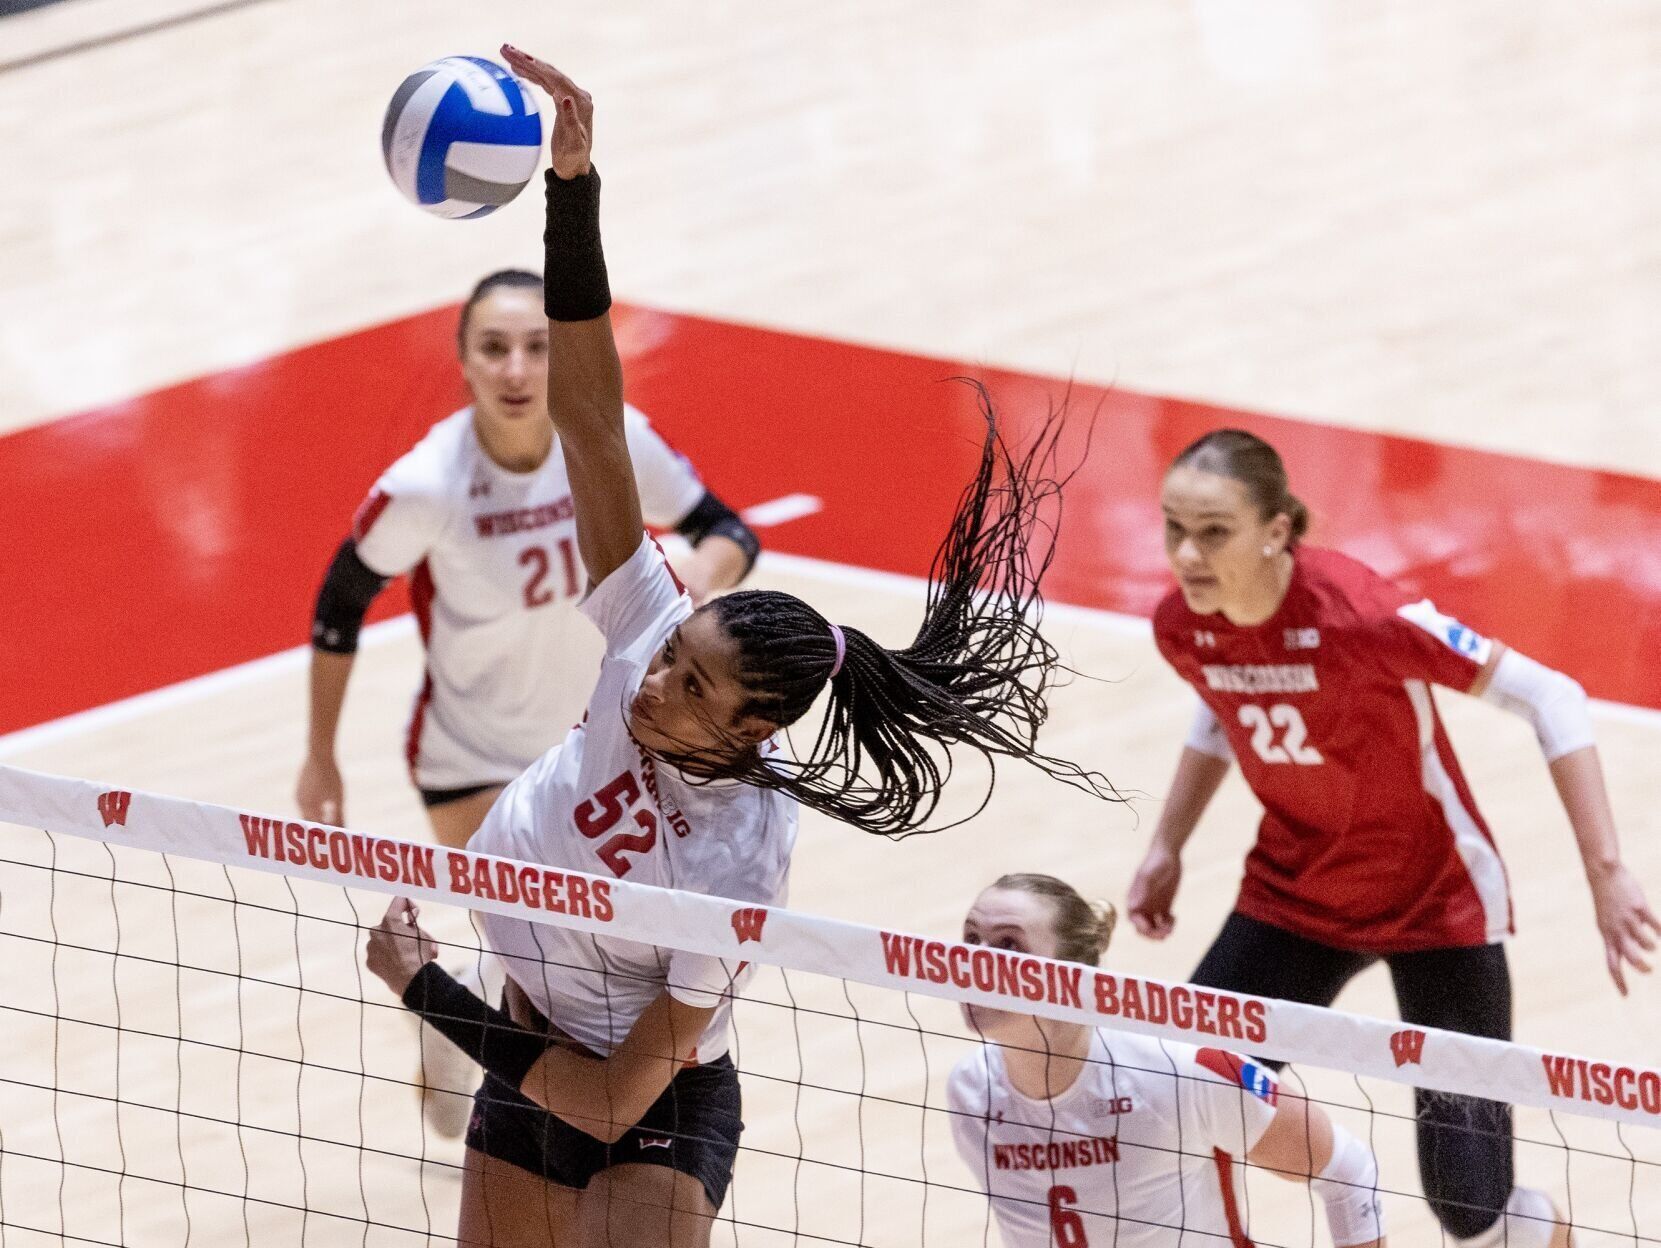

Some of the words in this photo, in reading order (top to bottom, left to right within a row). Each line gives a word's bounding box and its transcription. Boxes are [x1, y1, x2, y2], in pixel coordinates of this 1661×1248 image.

[518, 537, 580, 609] 21
[1237, 703, 1325, 765] 22
[574, 770, 657, 879] 52
[239, 814, 437, 889] WISCONSIN
[448, 852, 614, 922] BADGERS
[881, 931, 1082, 1009] WISCONSIN
[1094, 973, 1267, 1044] BADGERS
[1541, 1054, 1661, 1115] WISCO
[994, 1135, 1121, 1171] WISCONSIN
[1047, 1184, 1089, 1248] 6
